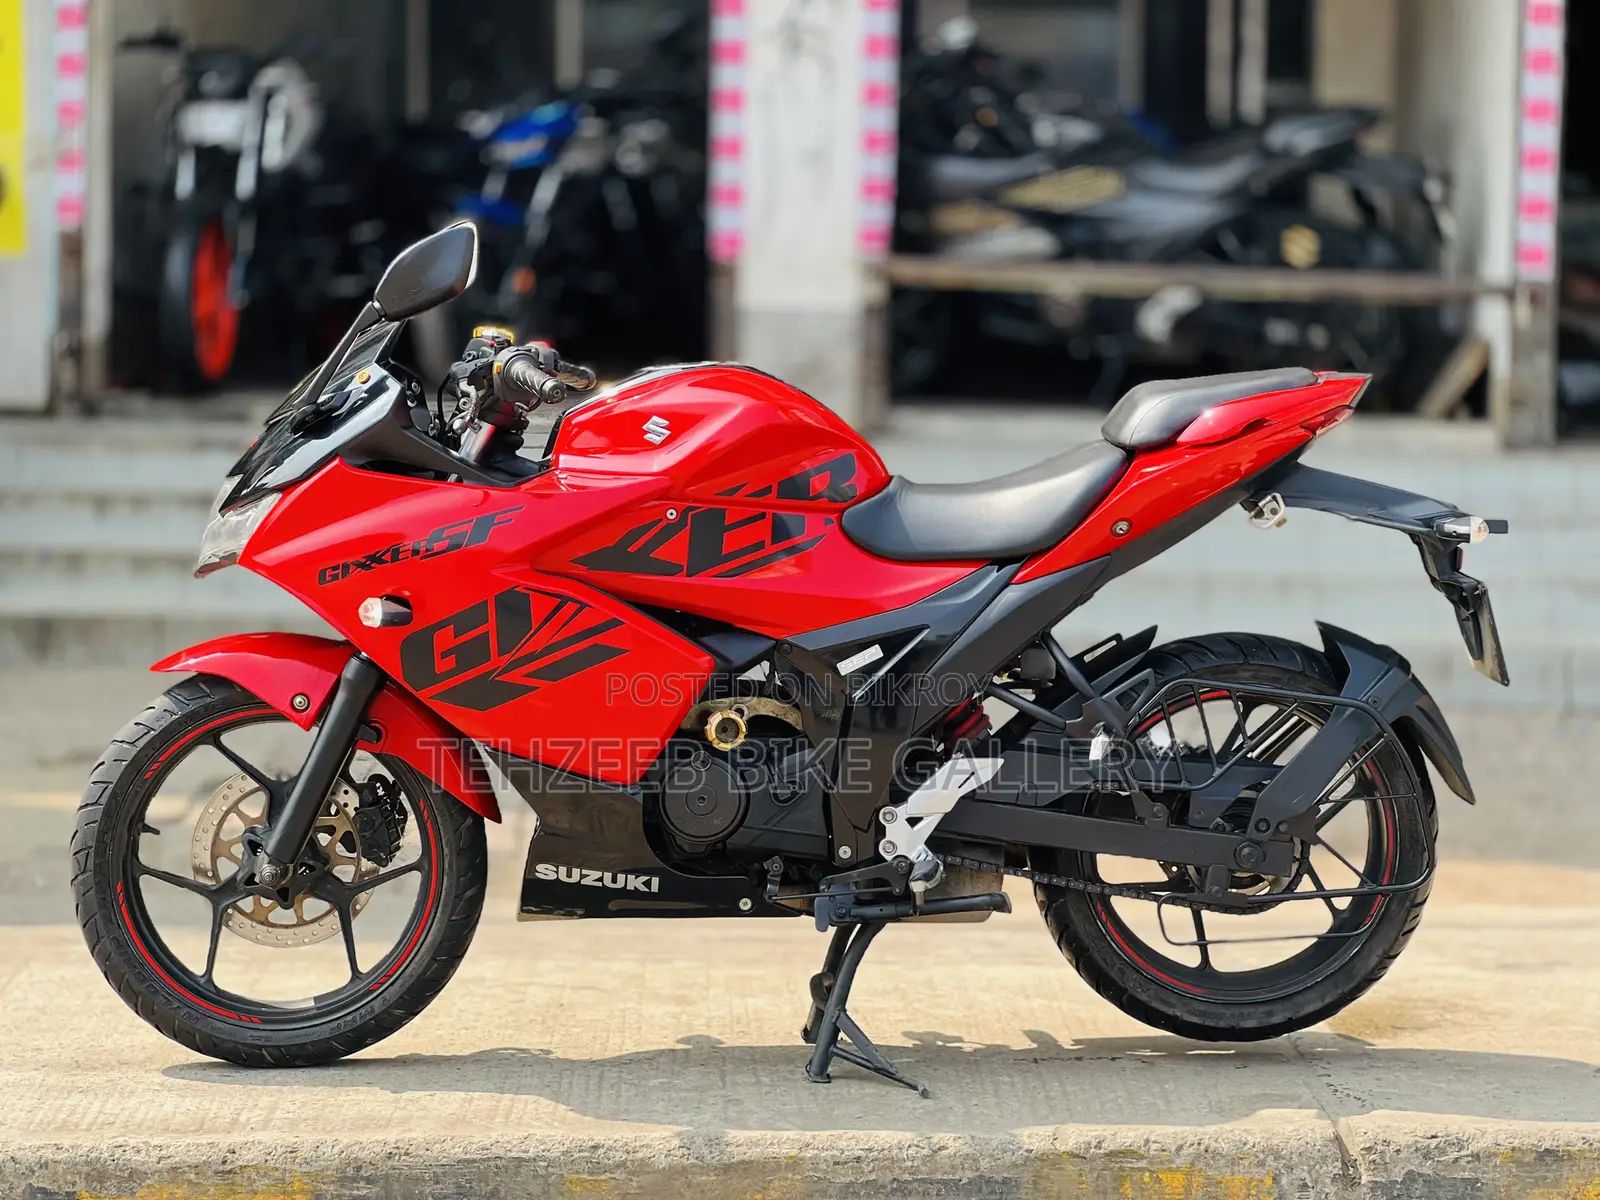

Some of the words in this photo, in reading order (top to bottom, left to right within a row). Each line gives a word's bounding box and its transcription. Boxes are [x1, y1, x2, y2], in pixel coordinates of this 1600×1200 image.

[317, 541, 433, 586] GIXXER
[420, 505, 525, 561] SF
[535, 863, 660, 893] SUZUKI
